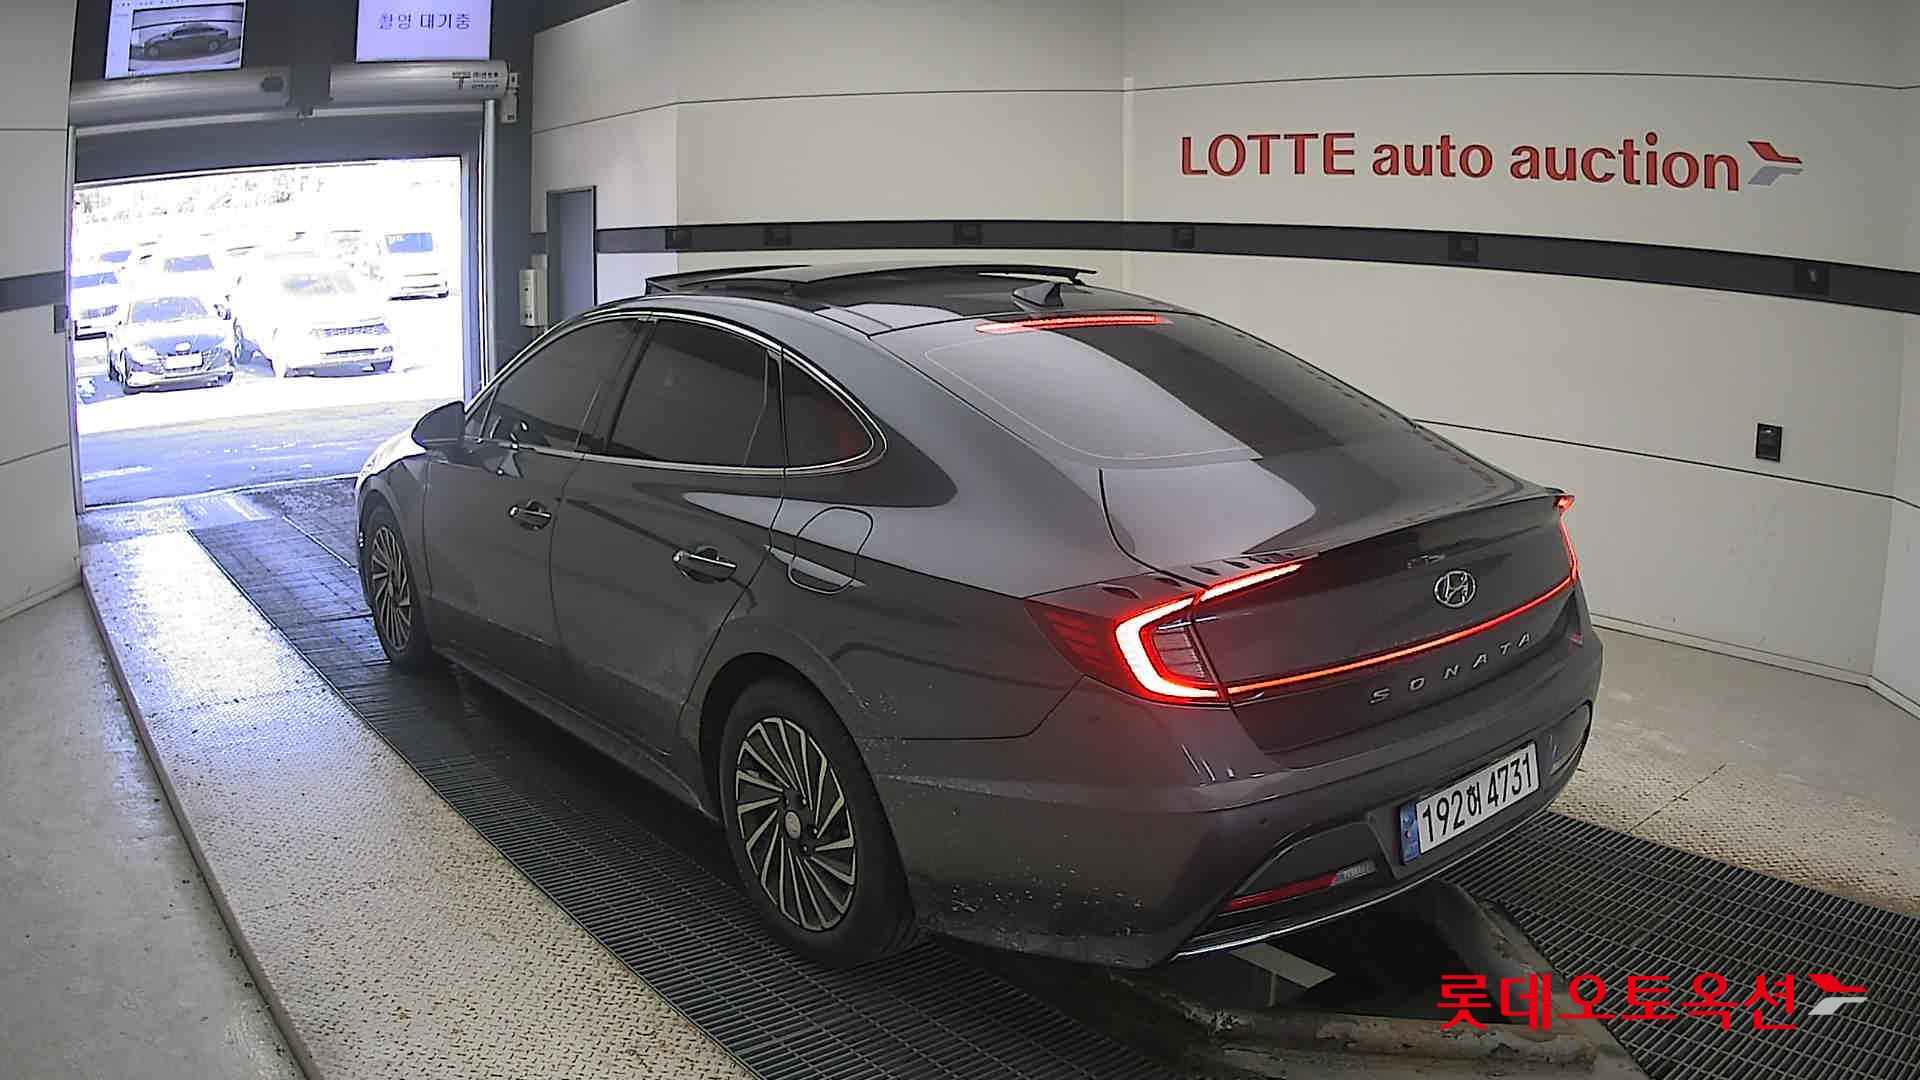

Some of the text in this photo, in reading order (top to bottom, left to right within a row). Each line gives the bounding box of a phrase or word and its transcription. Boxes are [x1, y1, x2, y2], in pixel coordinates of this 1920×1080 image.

[420, 13, 472, 30] 대기중
[1180, 131, 1740, 191] LOTTE auto auction
[1369, 631, 1532, 704] SONATA
[1422, 752, 1532, 842] 192허 4731
